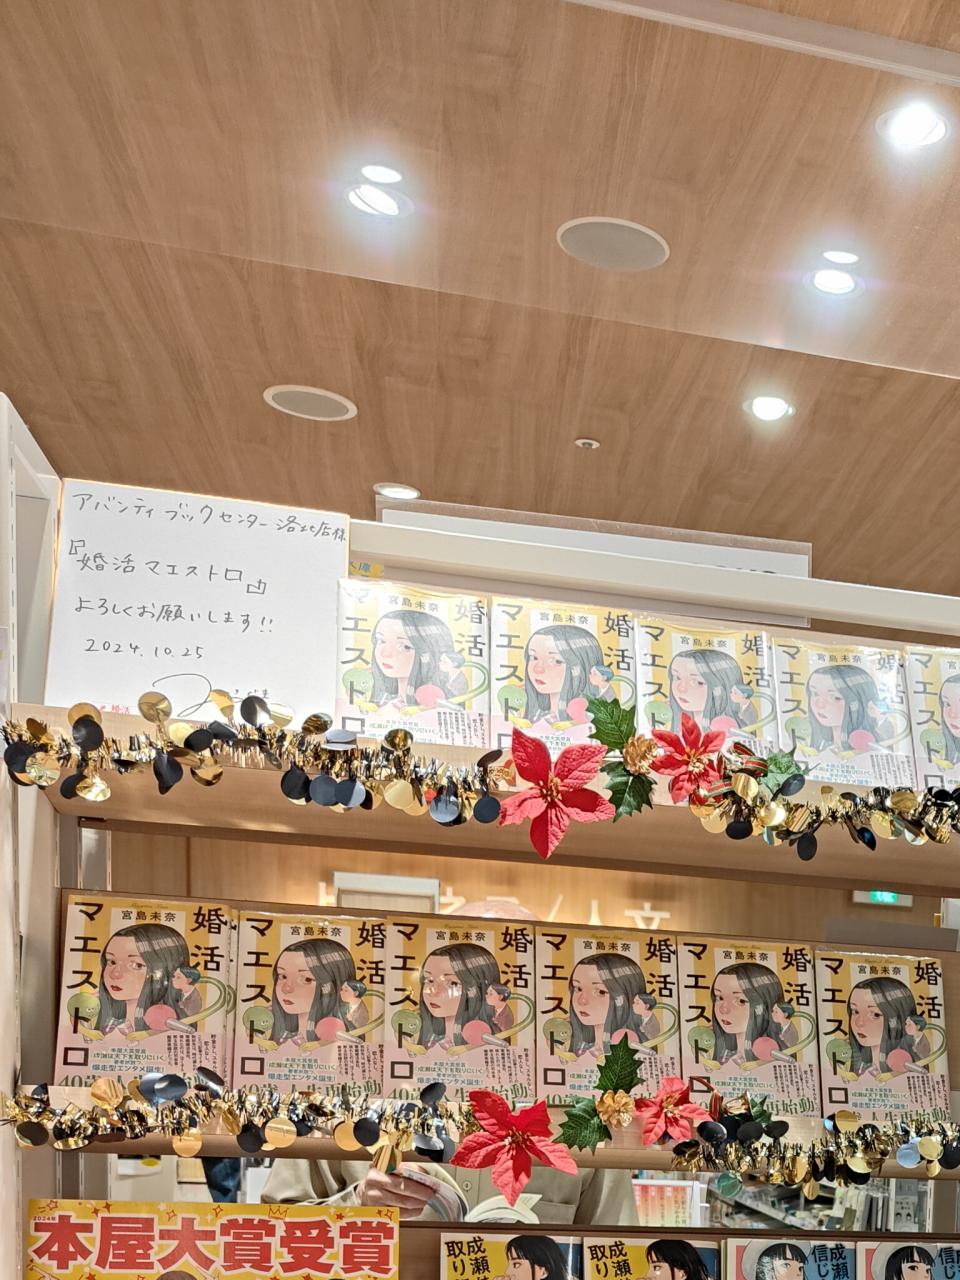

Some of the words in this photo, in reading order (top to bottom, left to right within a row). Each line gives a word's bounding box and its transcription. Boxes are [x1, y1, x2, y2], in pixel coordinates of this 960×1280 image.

[68, 539, 267, 595] 『婚活マエストロ』
[74, 596, 273, 633] よろしくお願いします!!
[603, 611, 635, 673] 婚活
[190, 905, 227, 974] 婚活
[500, 925, 533, 989] 婚活
[644, 936, 676, 999] 婚活
[63, 901, 105, 1067] マエストロ
[240, 917, 273, 1075] マエストロ
[389, 922, 420, 1080] マエストロ
[30, 1212, 397, 1277] 本屋大賞受賞
